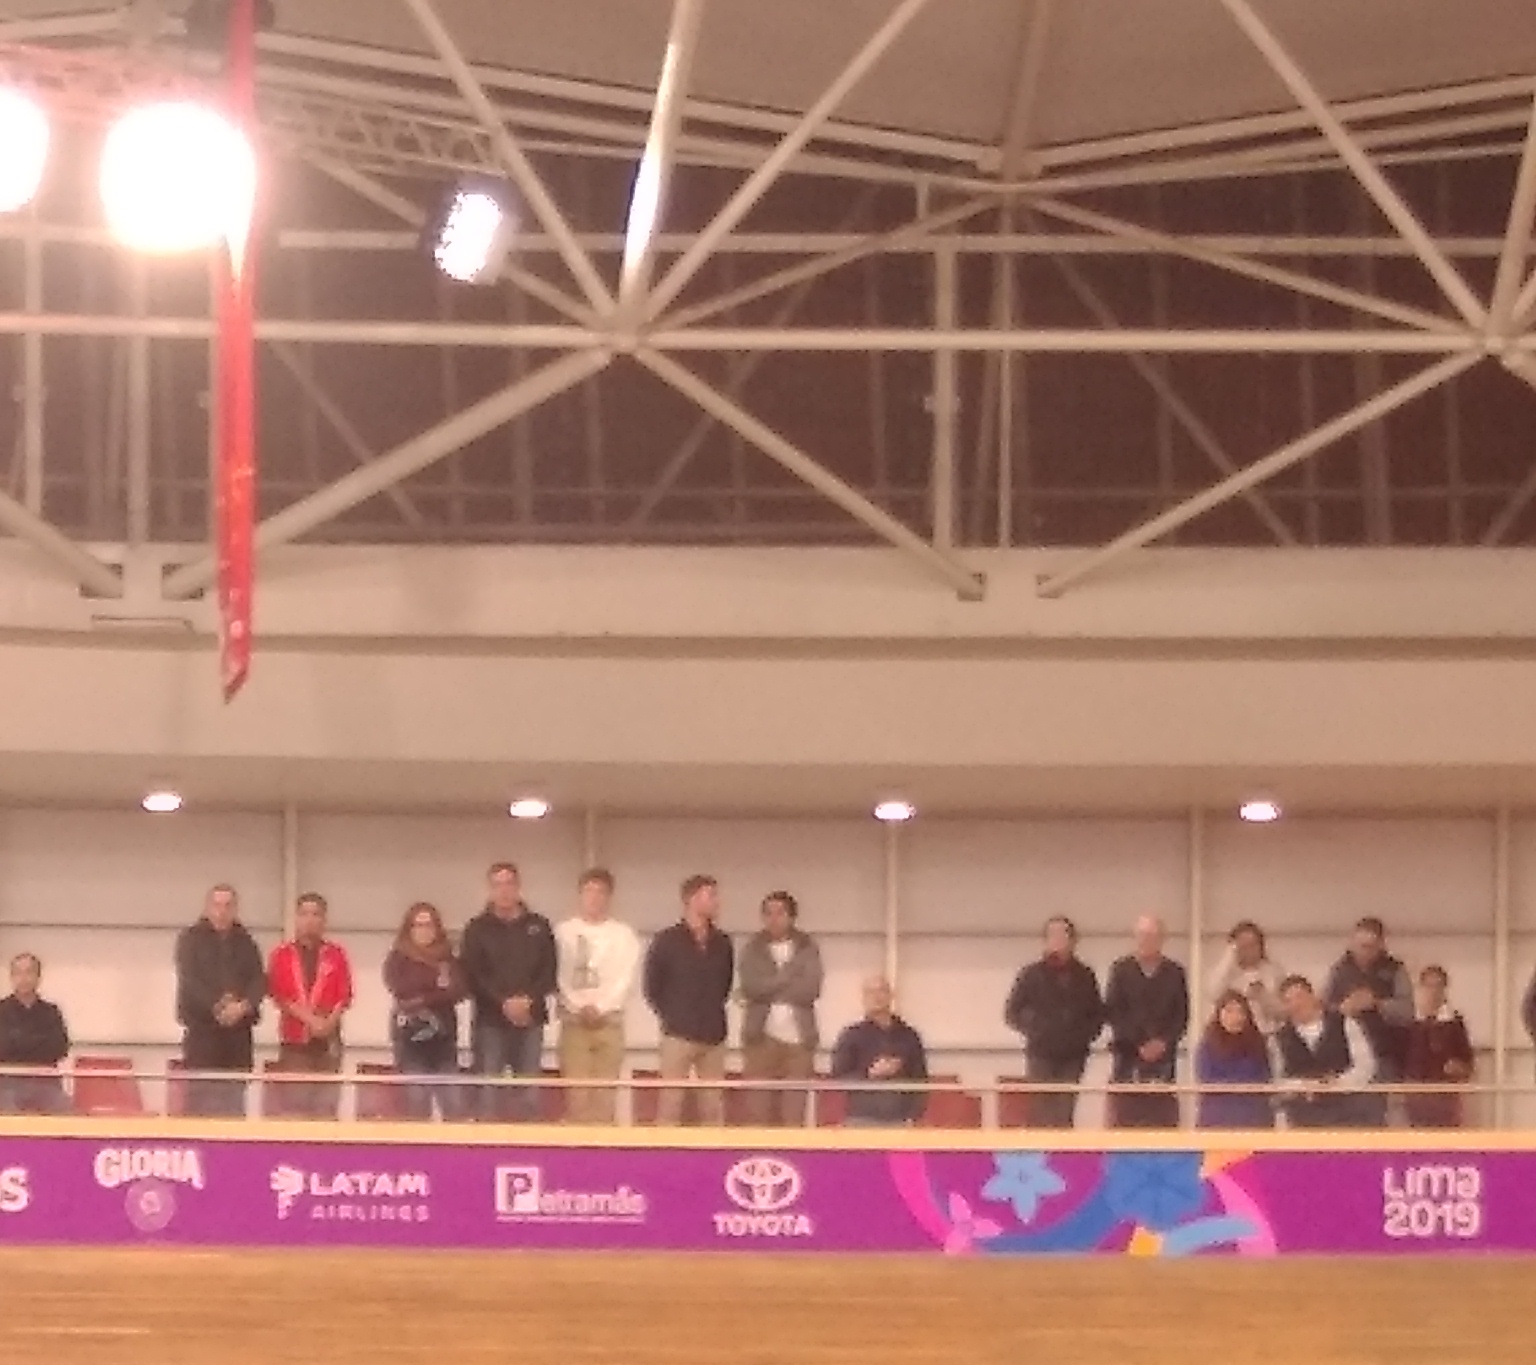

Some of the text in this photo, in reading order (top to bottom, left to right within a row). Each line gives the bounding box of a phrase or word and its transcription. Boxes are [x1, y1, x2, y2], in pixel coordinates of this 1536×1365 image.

[94, 1149, 204, 1190] GLORIA
[310, 1172, 430, 1196] LATAM
[311, 1205, 430, 1222] AIRLINES
[714, 1214, 811, 1236] TOYOTA
[1383, 1201, 1480, 1236] 2019
